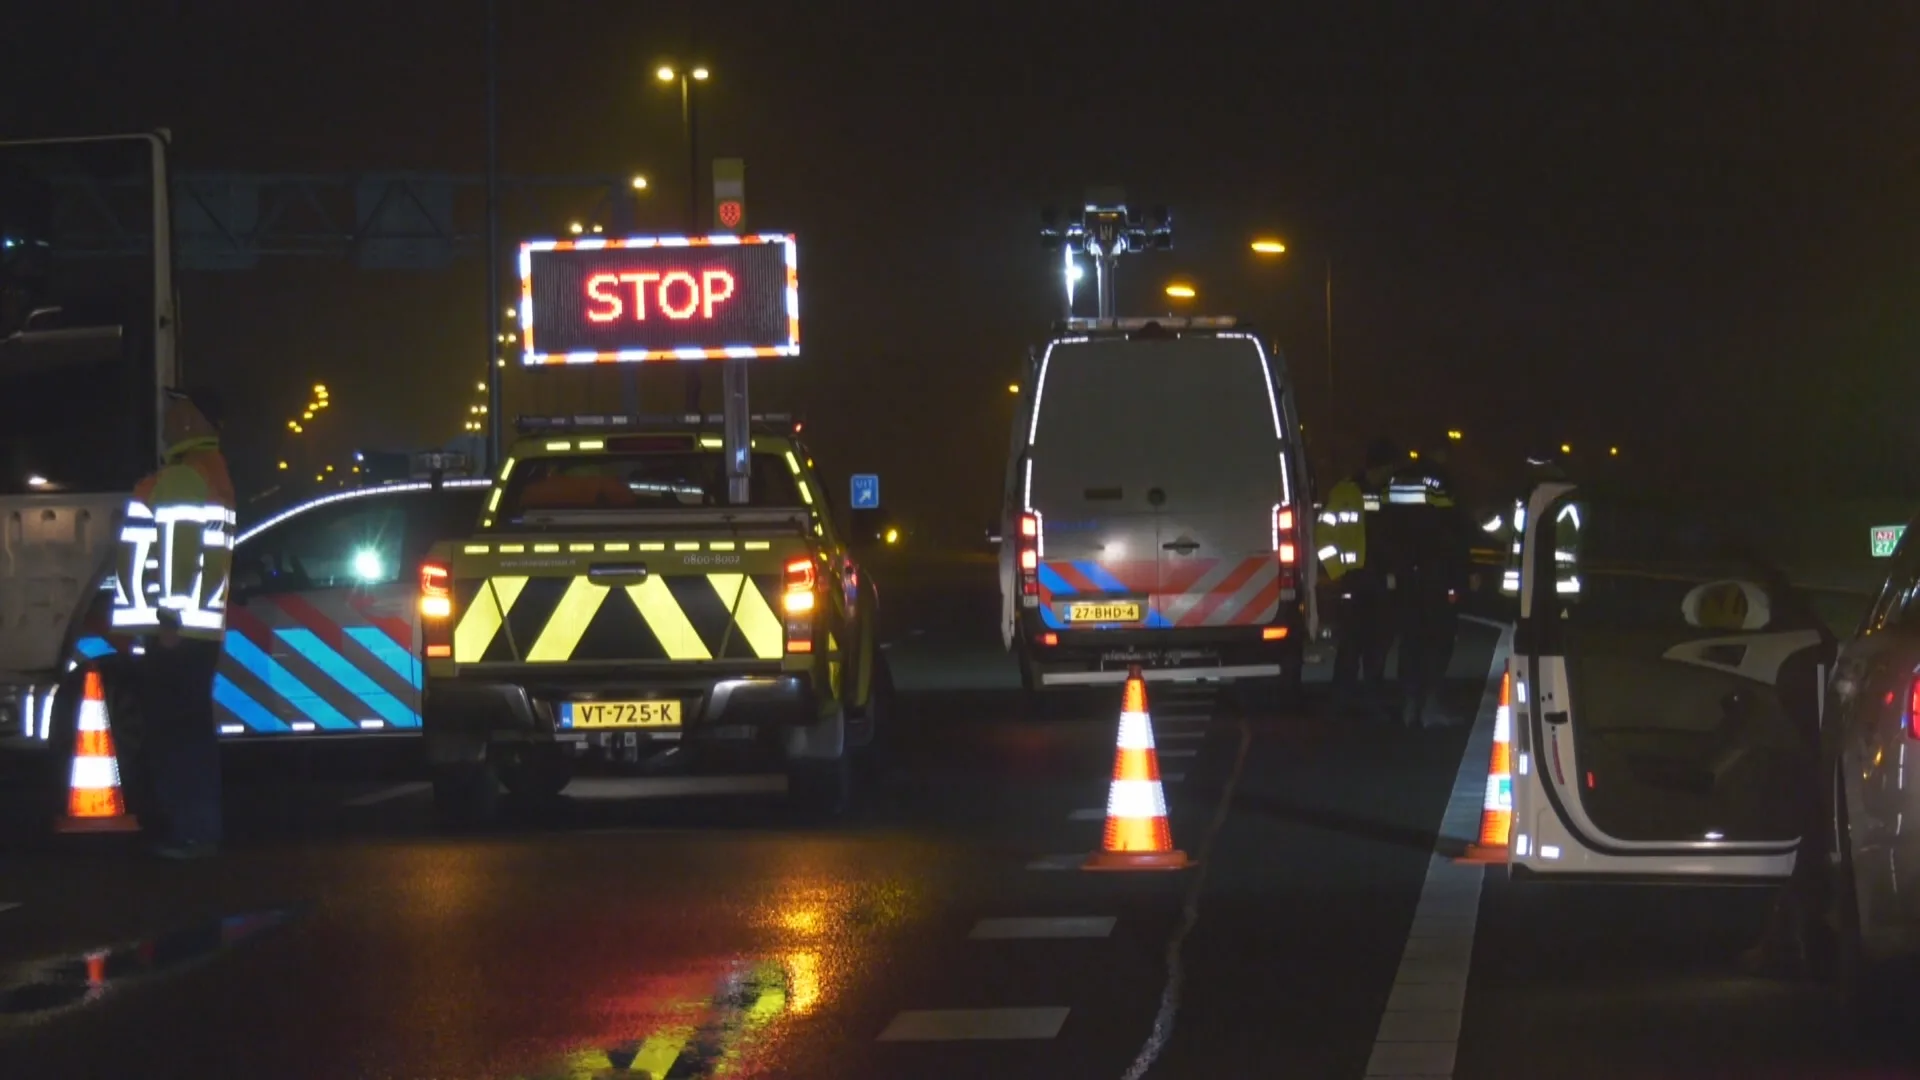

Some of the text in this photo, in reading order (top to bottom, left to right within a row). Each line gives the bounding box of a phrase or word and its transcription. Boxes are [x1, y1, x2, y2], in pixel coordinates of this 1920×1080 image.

[587, 271, 735, 322] STOP
[855, 479, 872, 489] UIT
[1075, 606, 1134, 619] 27-BHD-4
[581, 703, 673, 723] VT-725-K
